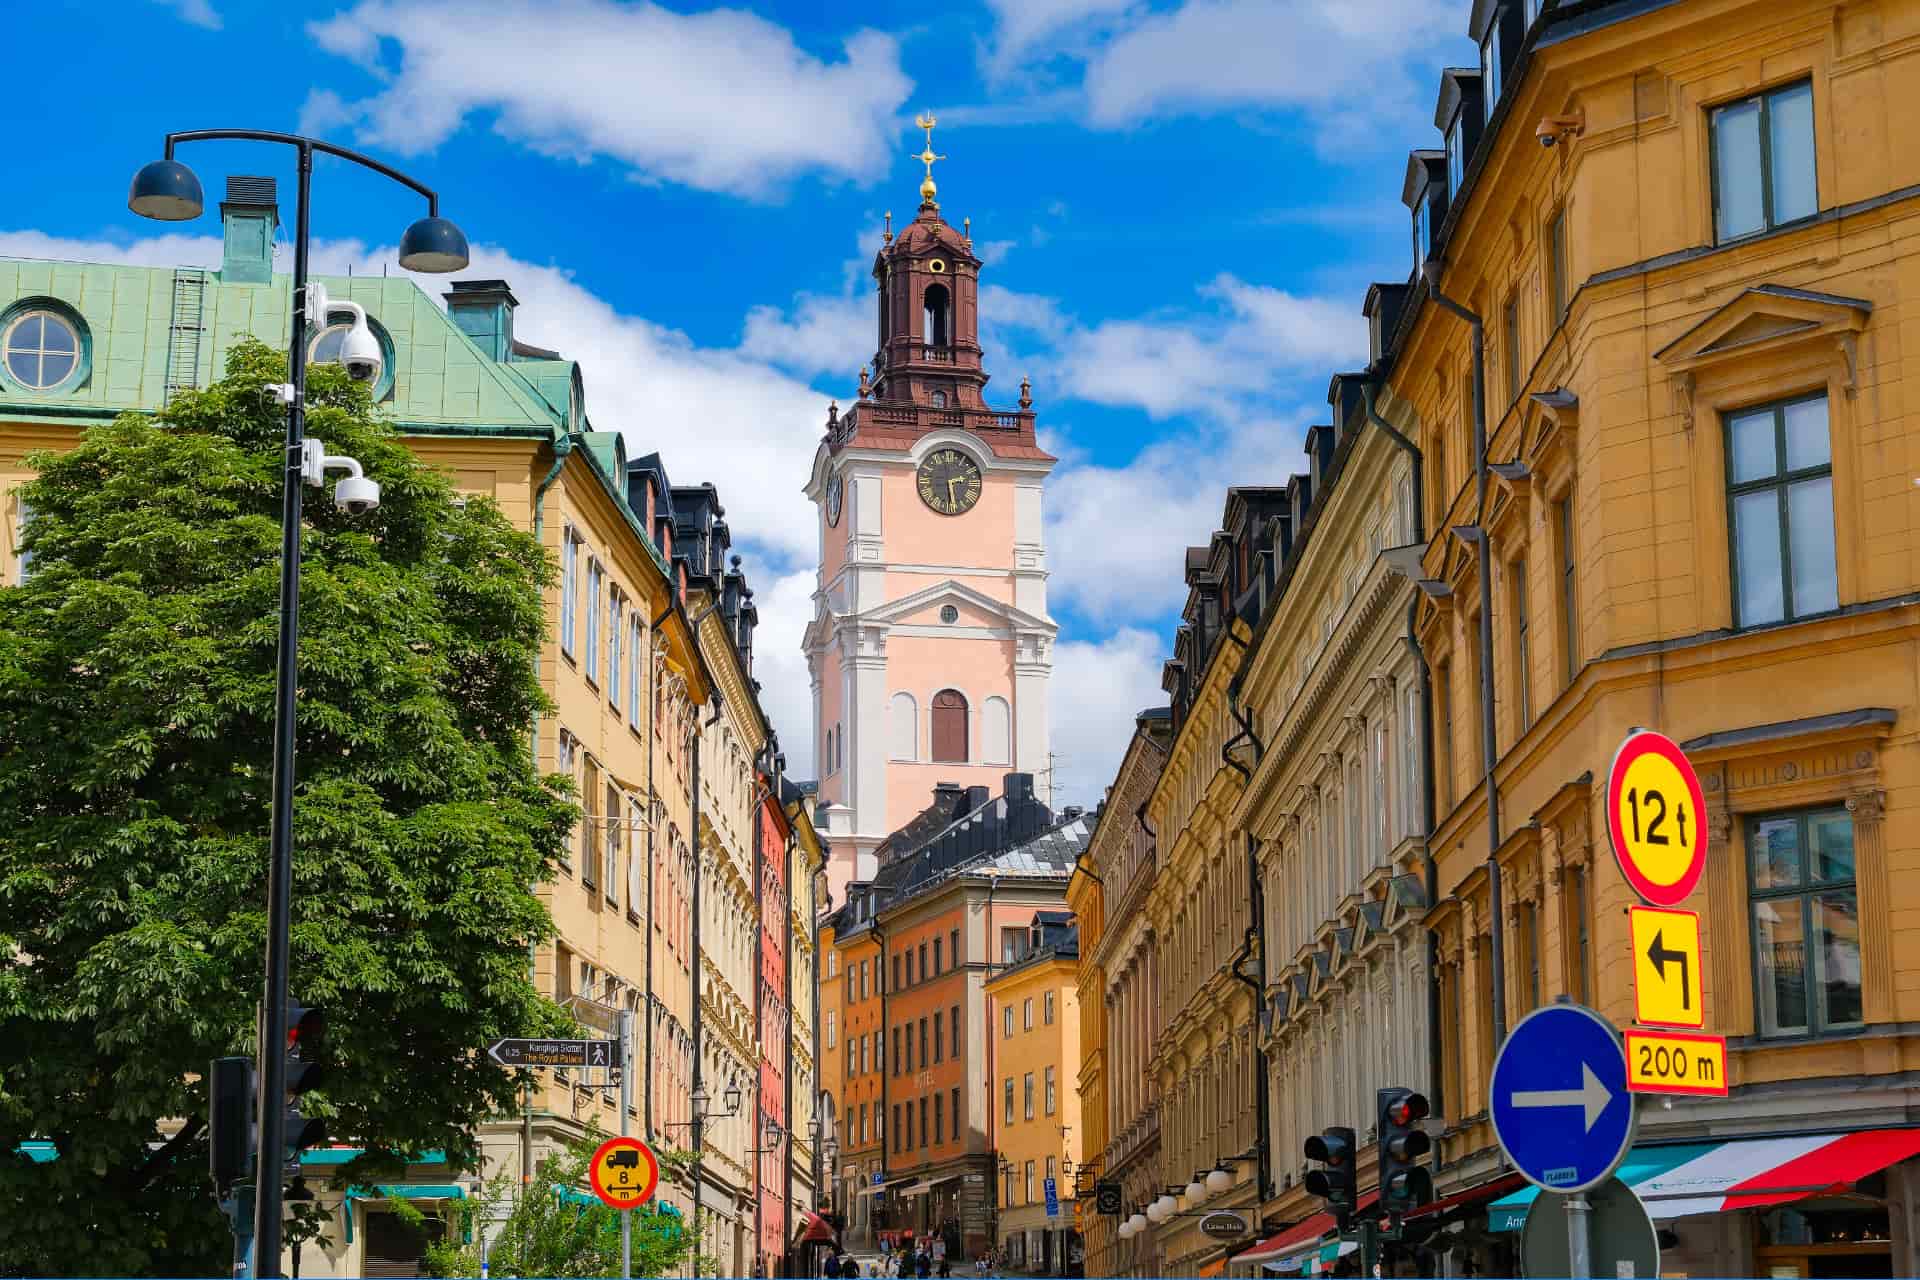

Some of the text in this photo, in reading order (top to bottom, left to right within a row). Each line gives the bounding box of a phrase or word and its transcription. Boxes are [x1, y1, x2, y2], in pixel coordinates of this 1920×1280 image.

[1627, 787, 1688, 848] 12 t
[1639, 1045, 1715, 1081] 200 m
[619, 1171, 629, 1184] 8
[620, 1191, 630, 1199] m
